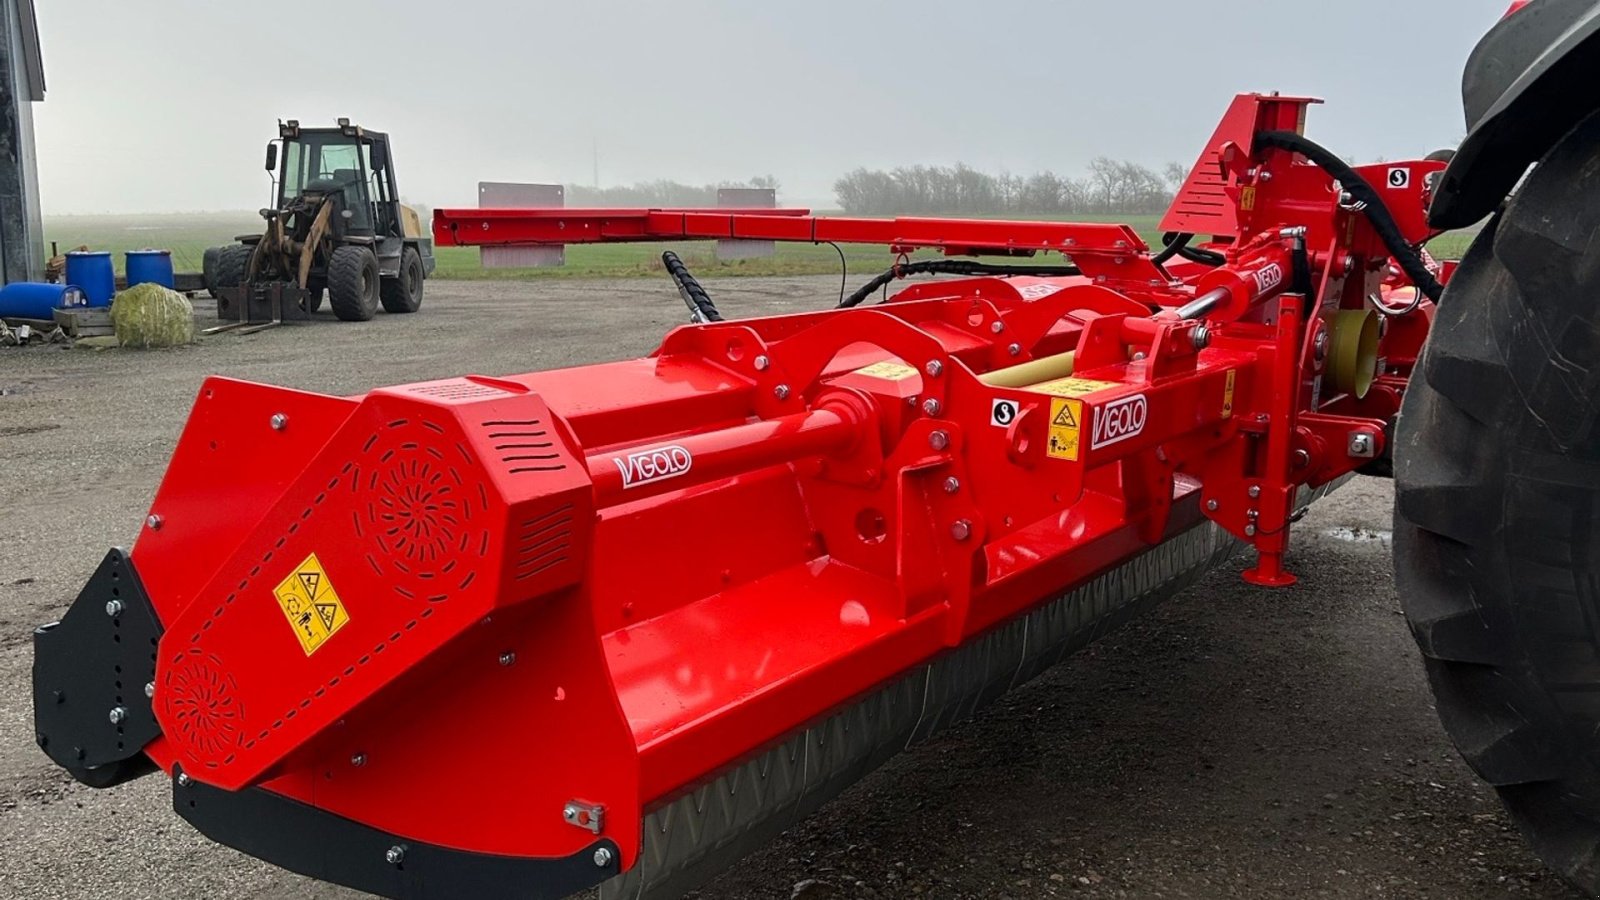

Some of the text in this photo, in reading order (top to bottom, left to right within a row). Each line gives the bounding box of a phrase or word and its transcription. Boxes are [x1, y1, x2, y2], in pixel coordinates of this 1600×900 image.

[1252, 263, 1281, 293] VIGOLO
[1093, 397, 1145, 446] VIGOLO
[614, 447, 690, 485] VIGOLO
